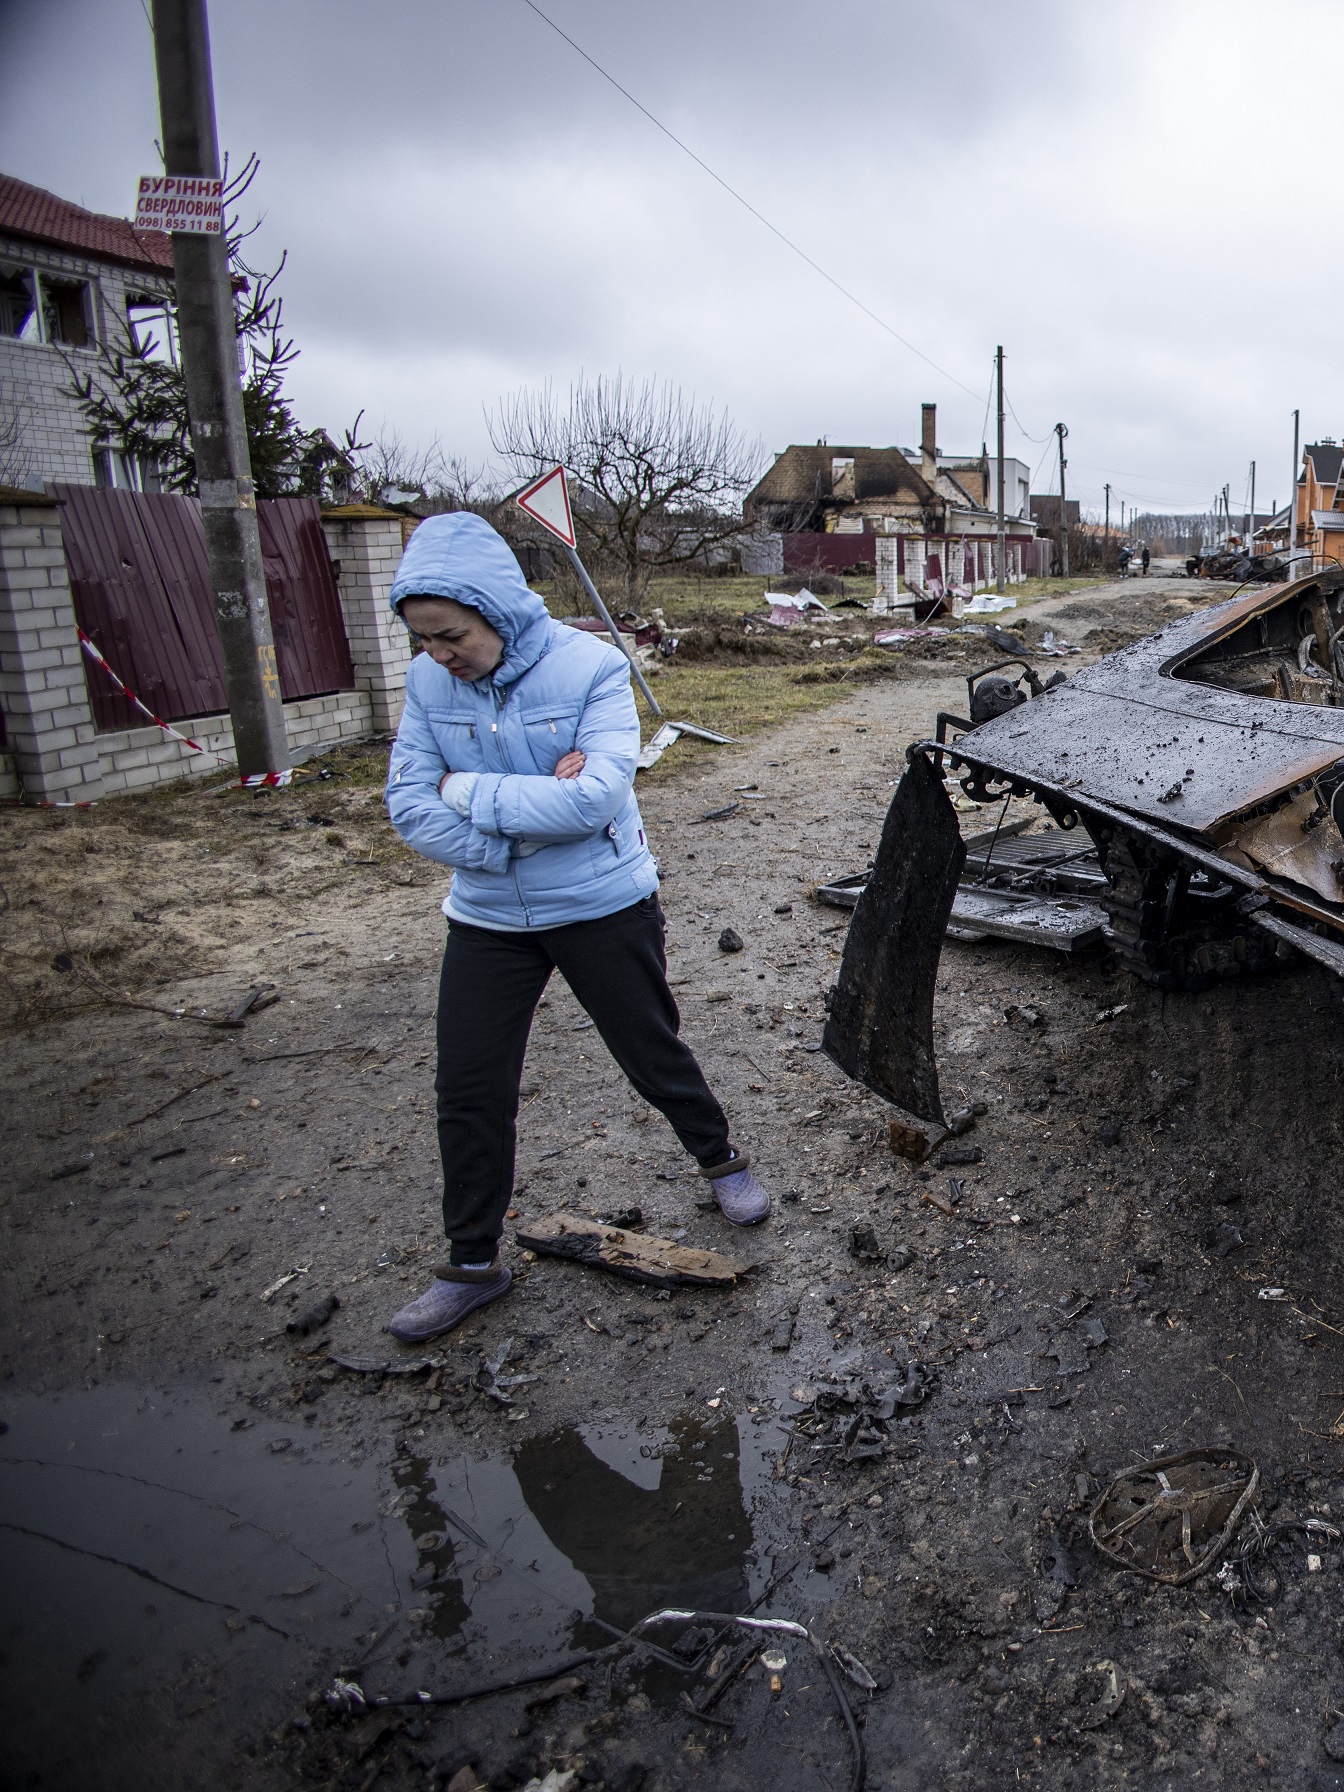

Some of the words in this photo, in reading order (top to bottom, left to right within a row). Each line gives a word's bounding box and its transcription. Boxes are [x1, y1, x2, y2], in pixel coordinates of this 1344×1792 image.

[139, 177, 223, 197] БУРІННЯ
[137, 197, 222, 217] СВЕРДЛОВИН
[134, 216, 163, 229] (098)
[165, 218, 187, 229] 855
[190, 220, 202, 230] 11
[205, 221, 219, 232] 88
